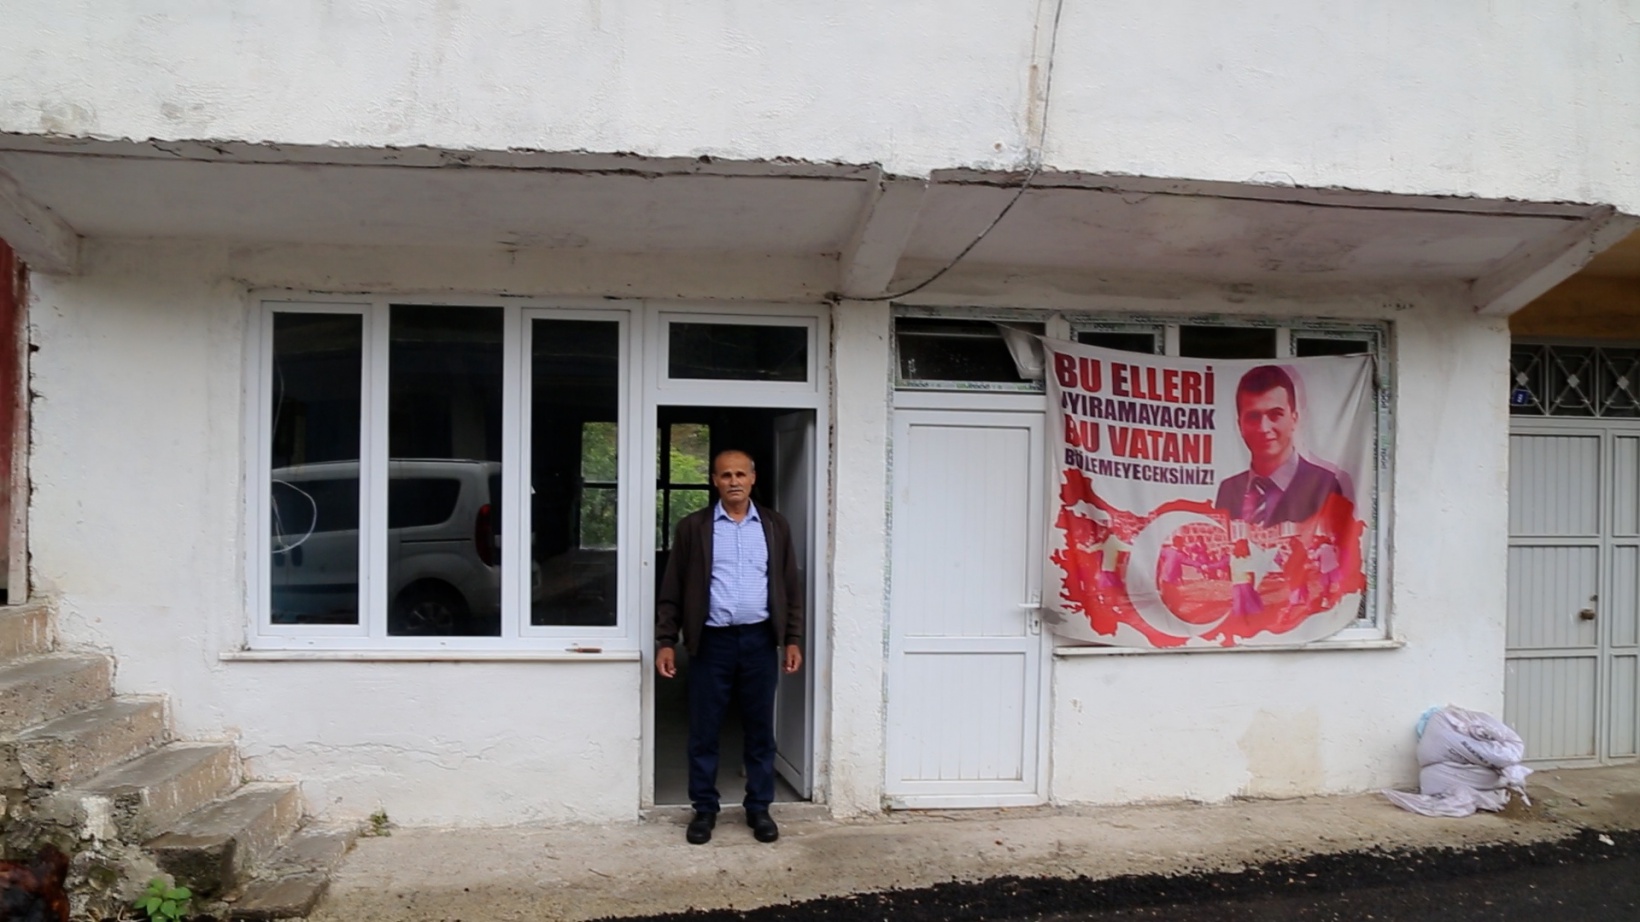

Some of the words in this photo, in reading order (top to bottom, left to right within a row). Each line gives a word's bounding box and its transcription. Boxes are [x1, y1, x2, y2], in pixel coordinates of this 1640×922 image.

[1054, 352, 1102, 393] BU
[1111, 362, 1214, 405] ELLERİ
[1065, 414, 1100, 453] BU
[1108, 425, 1212, 464] VATANI
